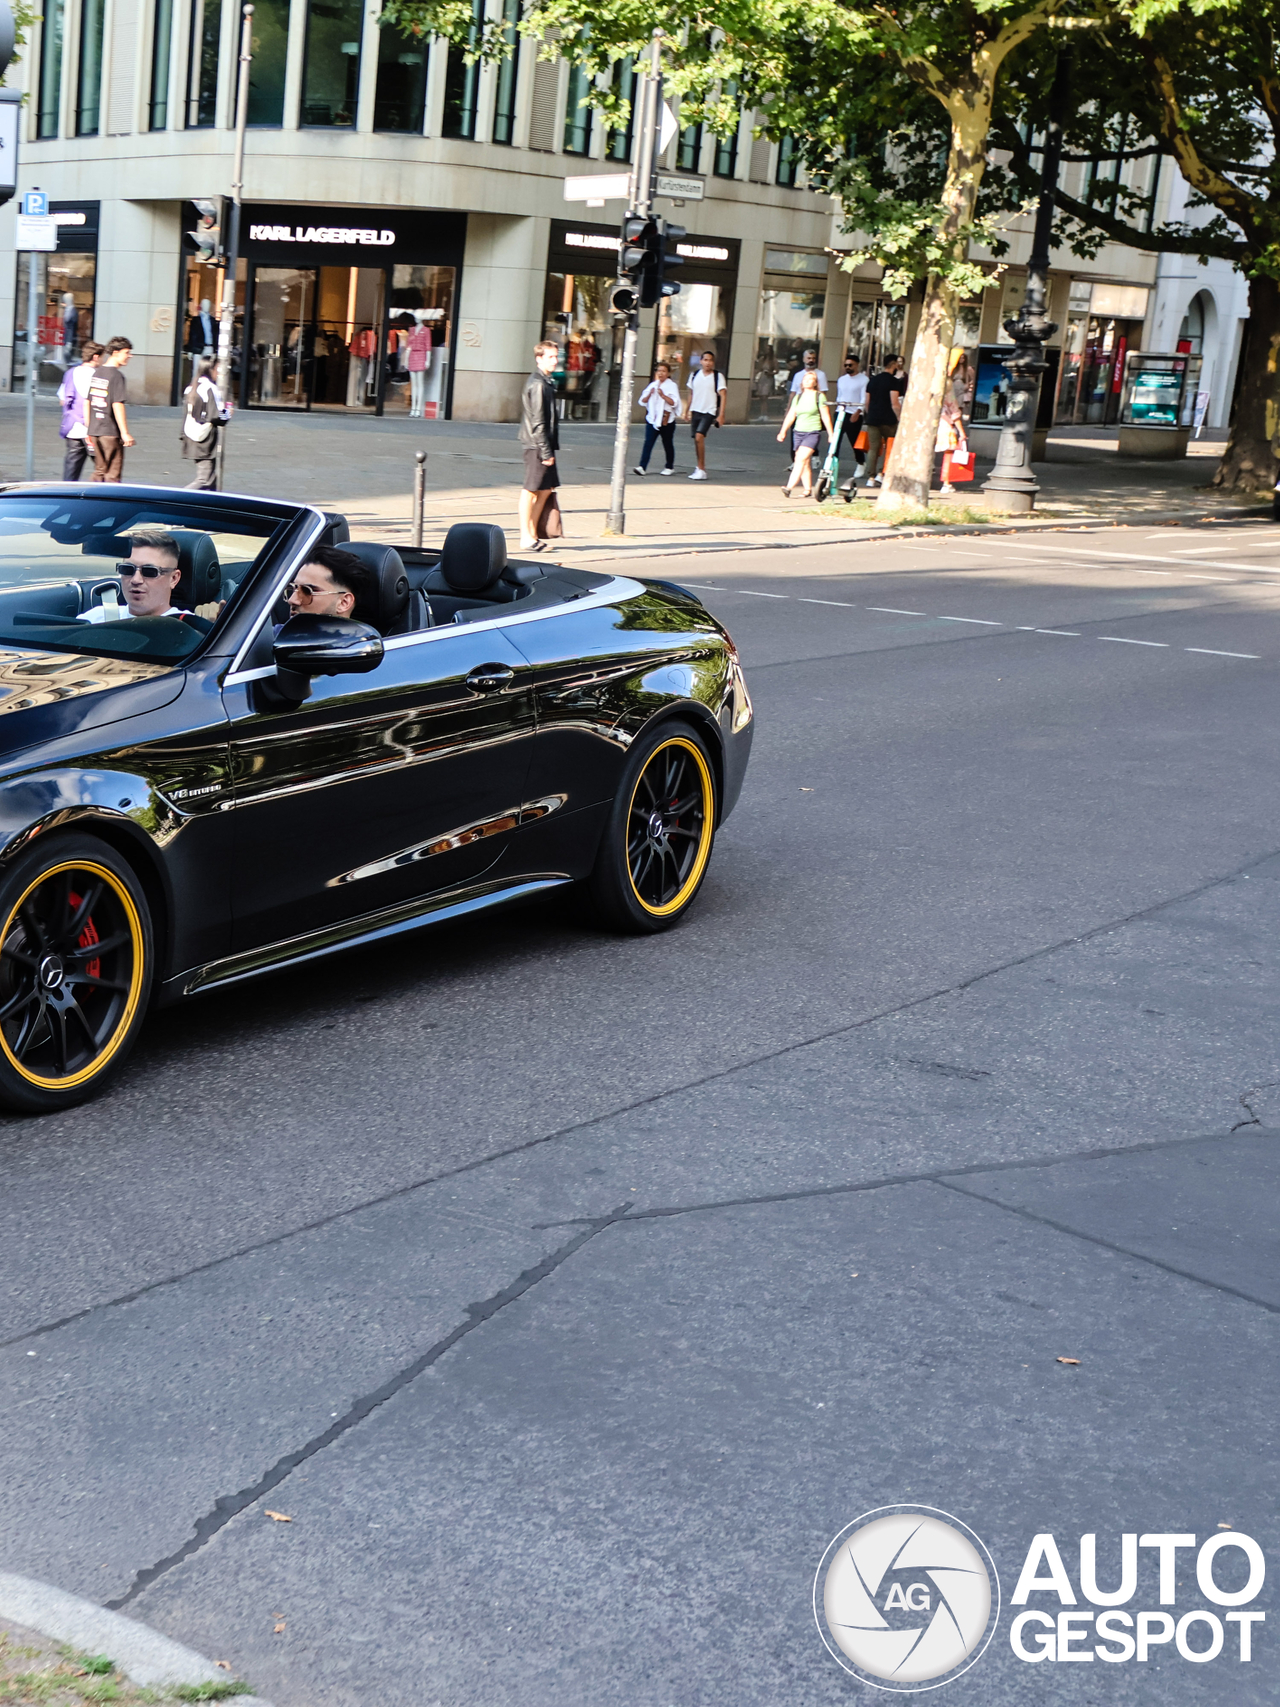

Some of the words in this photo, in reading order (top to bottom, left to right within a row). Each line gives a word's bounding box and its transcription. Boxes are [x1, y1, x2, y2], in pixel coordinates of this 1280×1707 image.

[27, 195, 43, 213] P
[250, 225, 295, 241] KARL
[296, 227, 395, 245] LAGERFELD
[168, 789, 188, 800] V8
